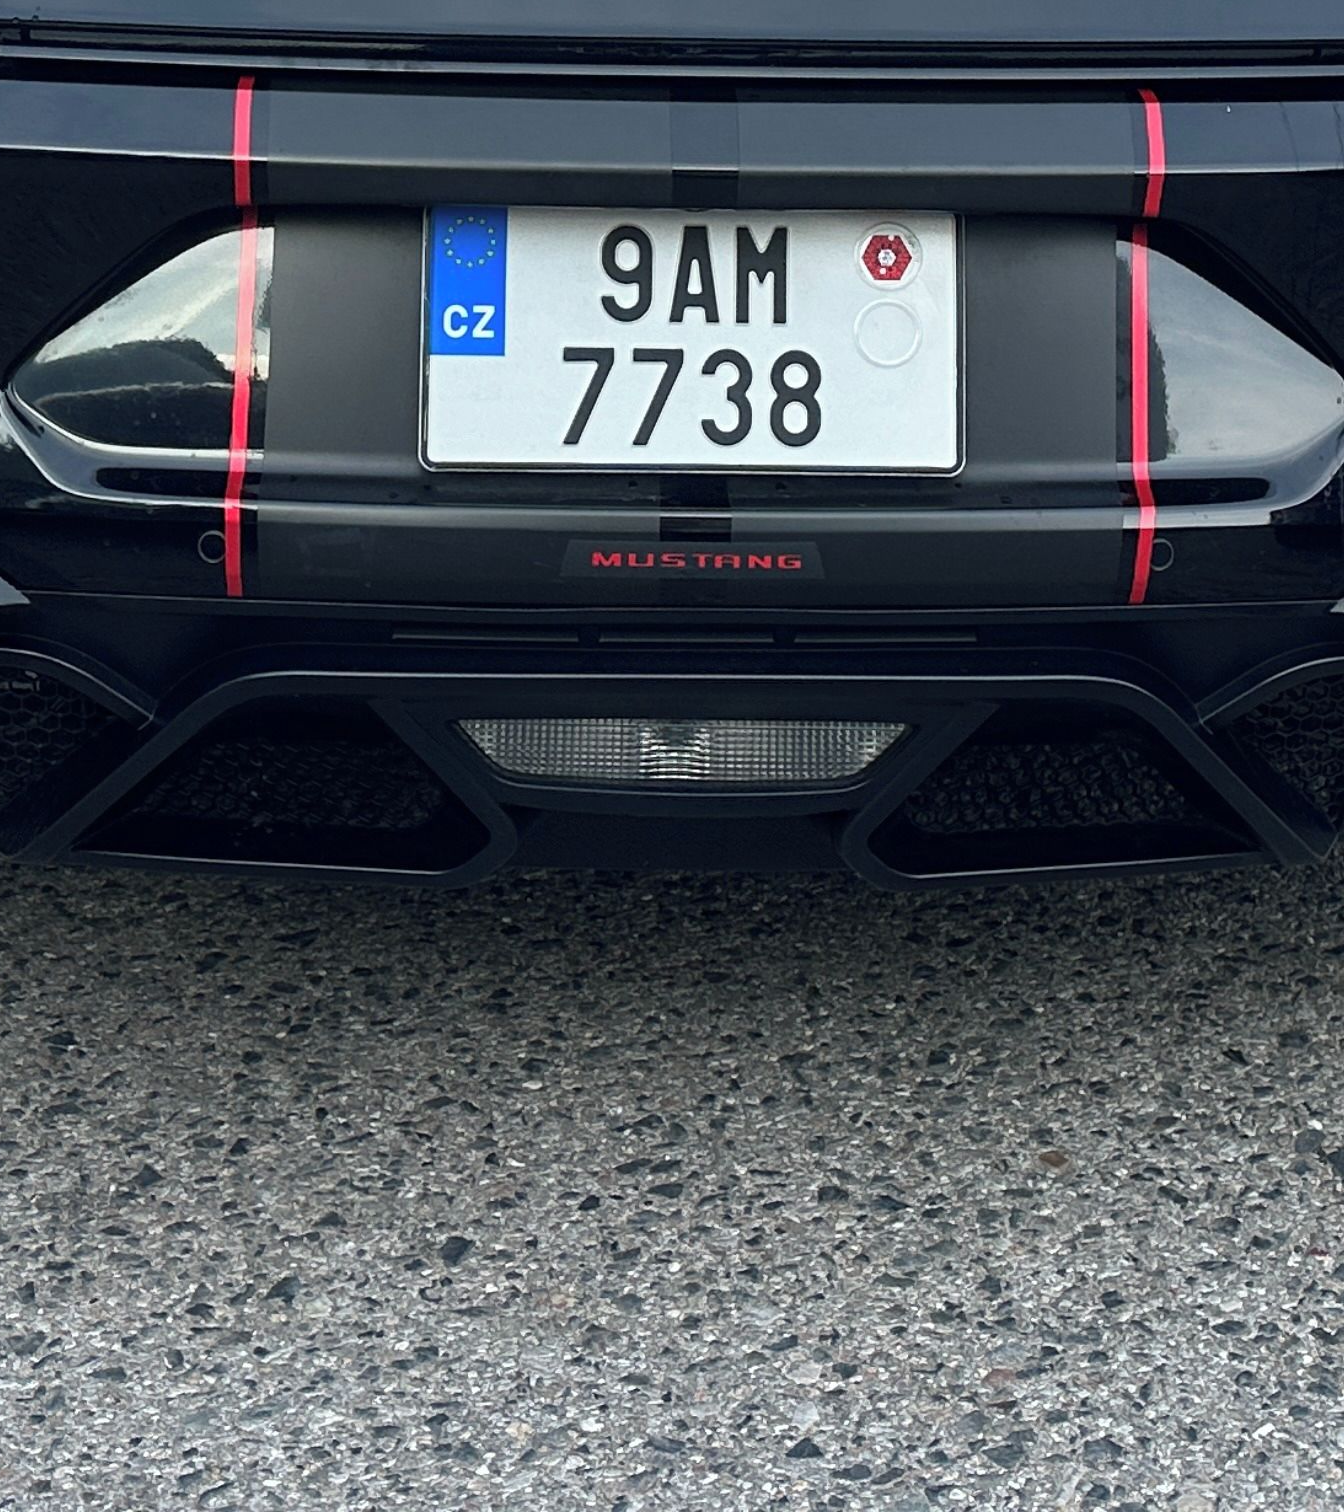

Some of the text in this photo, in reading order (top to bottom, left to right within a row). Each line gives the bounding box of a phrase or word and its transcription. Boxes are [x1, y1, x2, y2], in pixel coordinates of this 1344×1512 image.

[601, 225, 788, 324] 9AM
[442, 304, 496, 340] CZ
[563, 346, 822, 448] 7738
[591, 551, 803, 570] MUSTANG
